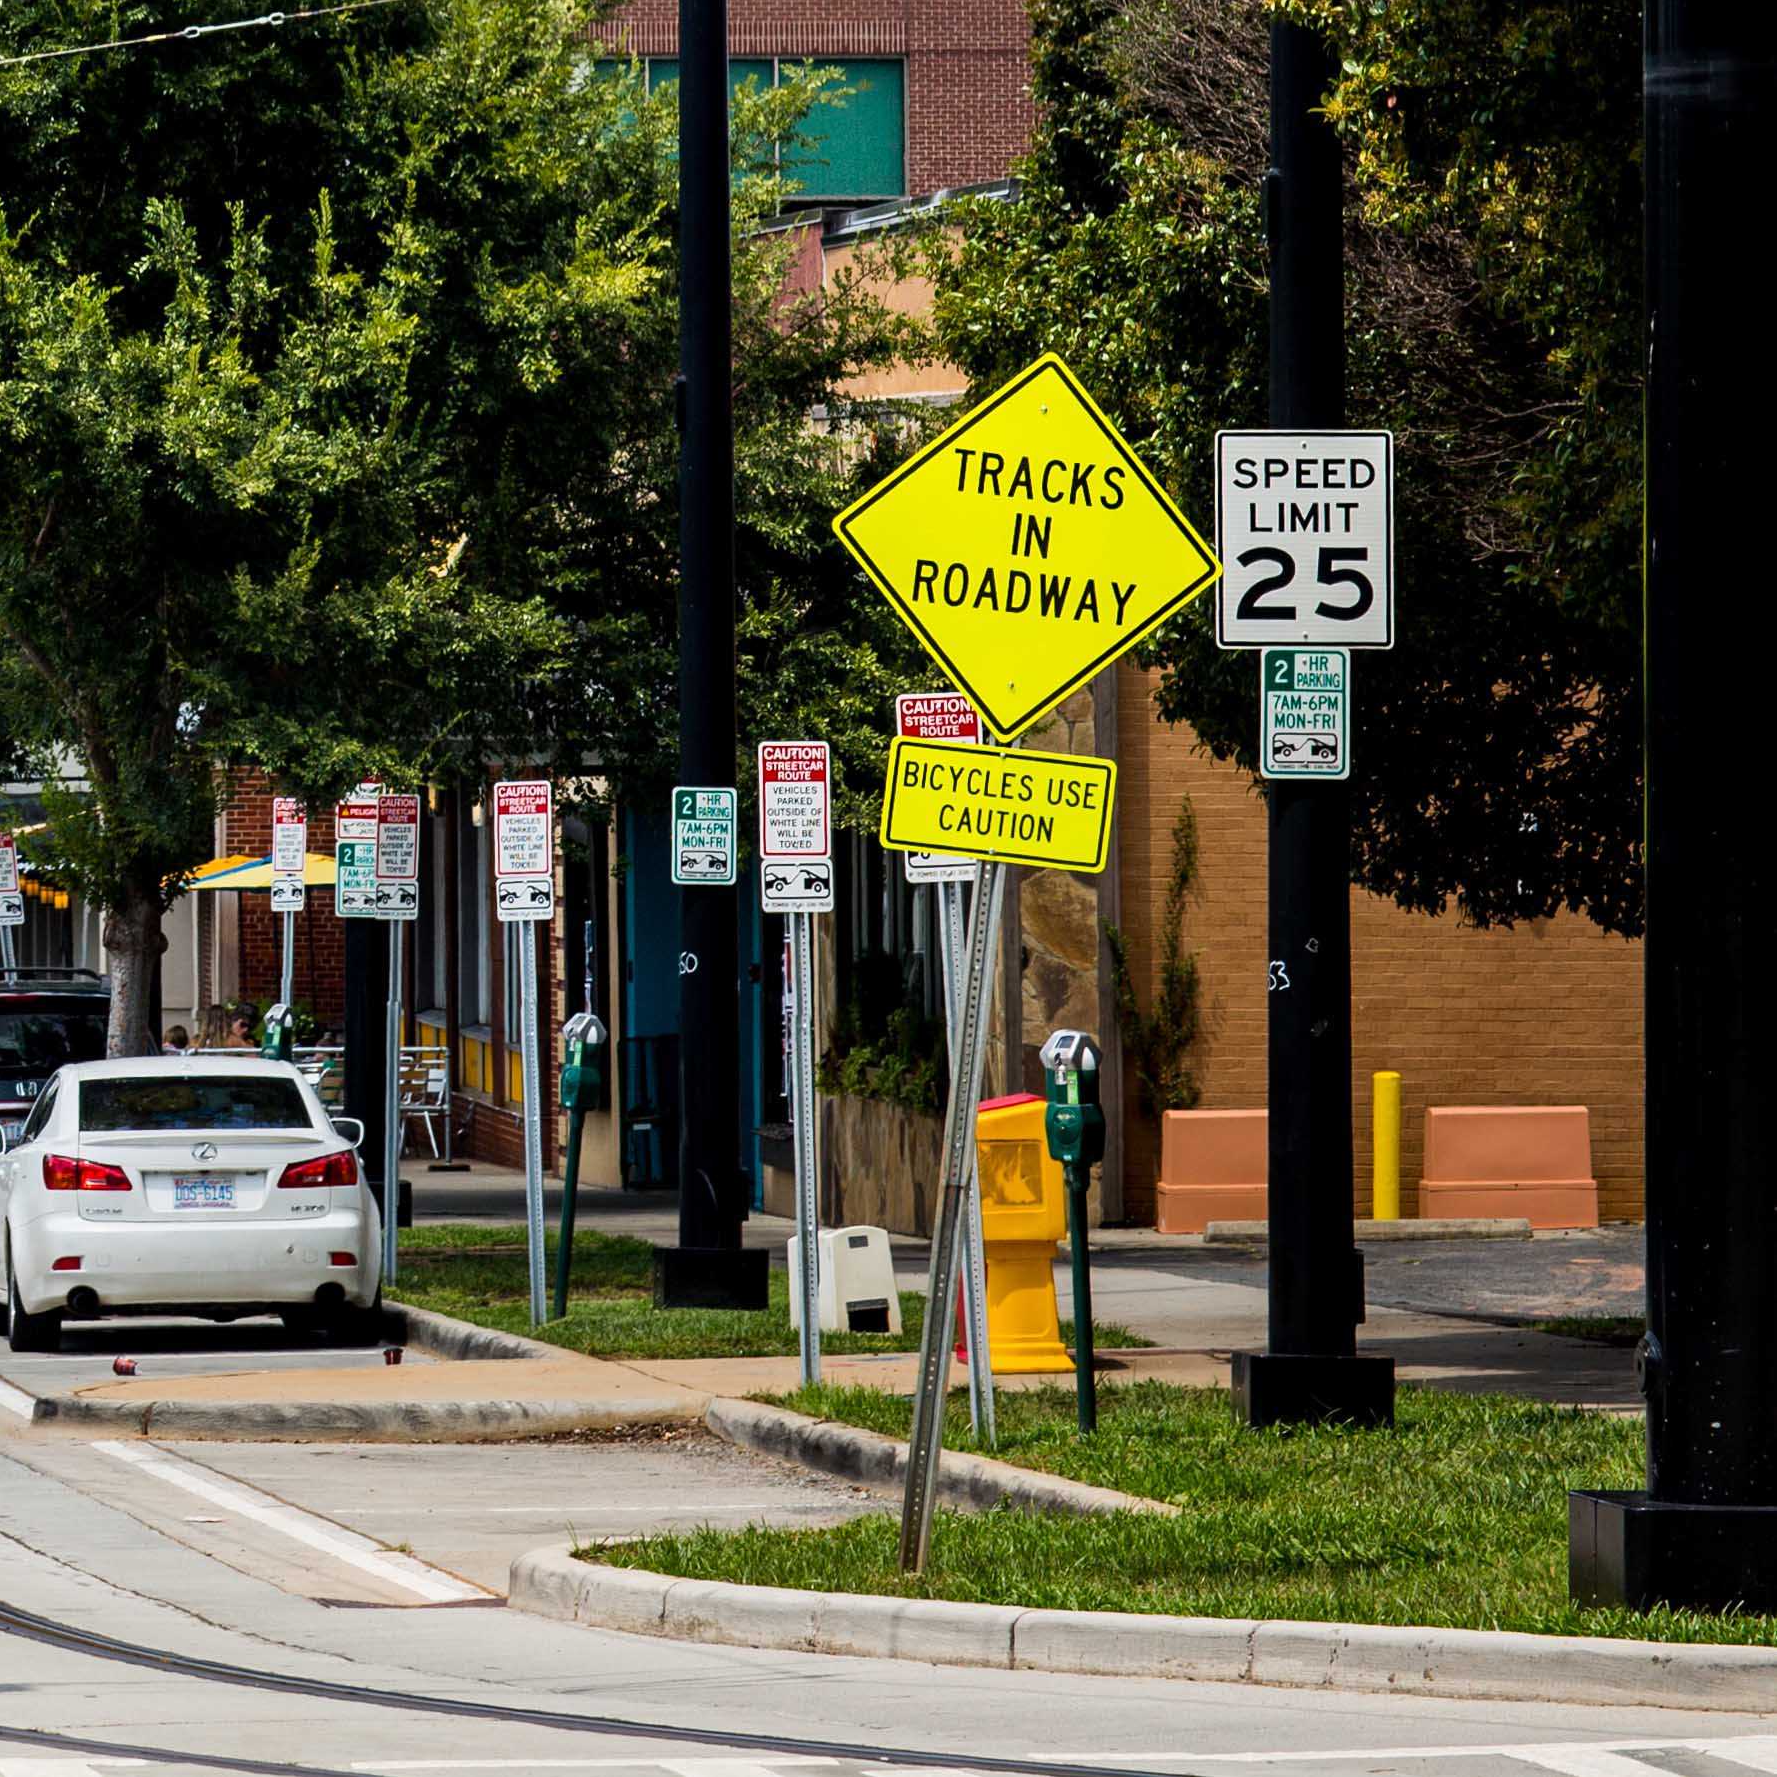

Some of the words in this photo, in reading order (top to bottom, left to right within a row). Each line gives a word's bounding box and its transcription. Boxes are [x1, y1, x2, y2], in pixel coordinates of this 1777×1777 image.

[954, 449, 1126, 510] TRACKS
[1233, 459, 1376, 490] SPEED
[1249, 503, 1359, 533] LIMIT
[1011, 514, 1052, 559] IN
[1237, 548, 1374, 621] 25
[912, 560, 1137, 626] ROADWAY
[1309, 656, 1328, 671] HR
[1274, 660, 1288, 683] 2
[1297, 673, 1340, 688] PARKING
[902, 698, 975, 715] CAUTION
[1273, 695, 1338, 711] 7AM-6PM
[904, 713, 974, 727] STREETCAR
[1274, 713, 1335, 729] MON-FRI
[920, 725, 960, 736] ROUTE
[763, 748, 825, 760] CAUTION!
[766, 761, 824, 771] STREETCAR
[778, 771, 811, 781] ROUTE
[498, 786, 546, 797] CAUTION!
[773, 786, 818, 795] VEHICLES
[903, 761, 1033, 804] BICYCLES
[1047, 779, 1099, 810] USE
[499, 797, 546, 807] STREETCAR
[682, 797, 693, 814] 2
[707, 794, 721, 805] HR
[777, 797, 813, 806] PARKED
[509, 805, 536, 813] ROUTE
[698, 807, 730, 817] PARKING
[767, 808, 807, 817] OUTSIDE
[811, 808, 823, 816] OF
[681, 823, 728, 835] 7AM-6PM
[769, 818, 797, 827] WHITE
[801, 818, 821, 827] LINE
[939, 804, 1054, 843] CAUTION
[777, 830, 797, 838] WILL
[802, 830, 814, 838] BE
[682, 836, 726, 848] MON-FRI
[779, 840, 812, 849] TOWED
[343, 847, 352, 863] 2
